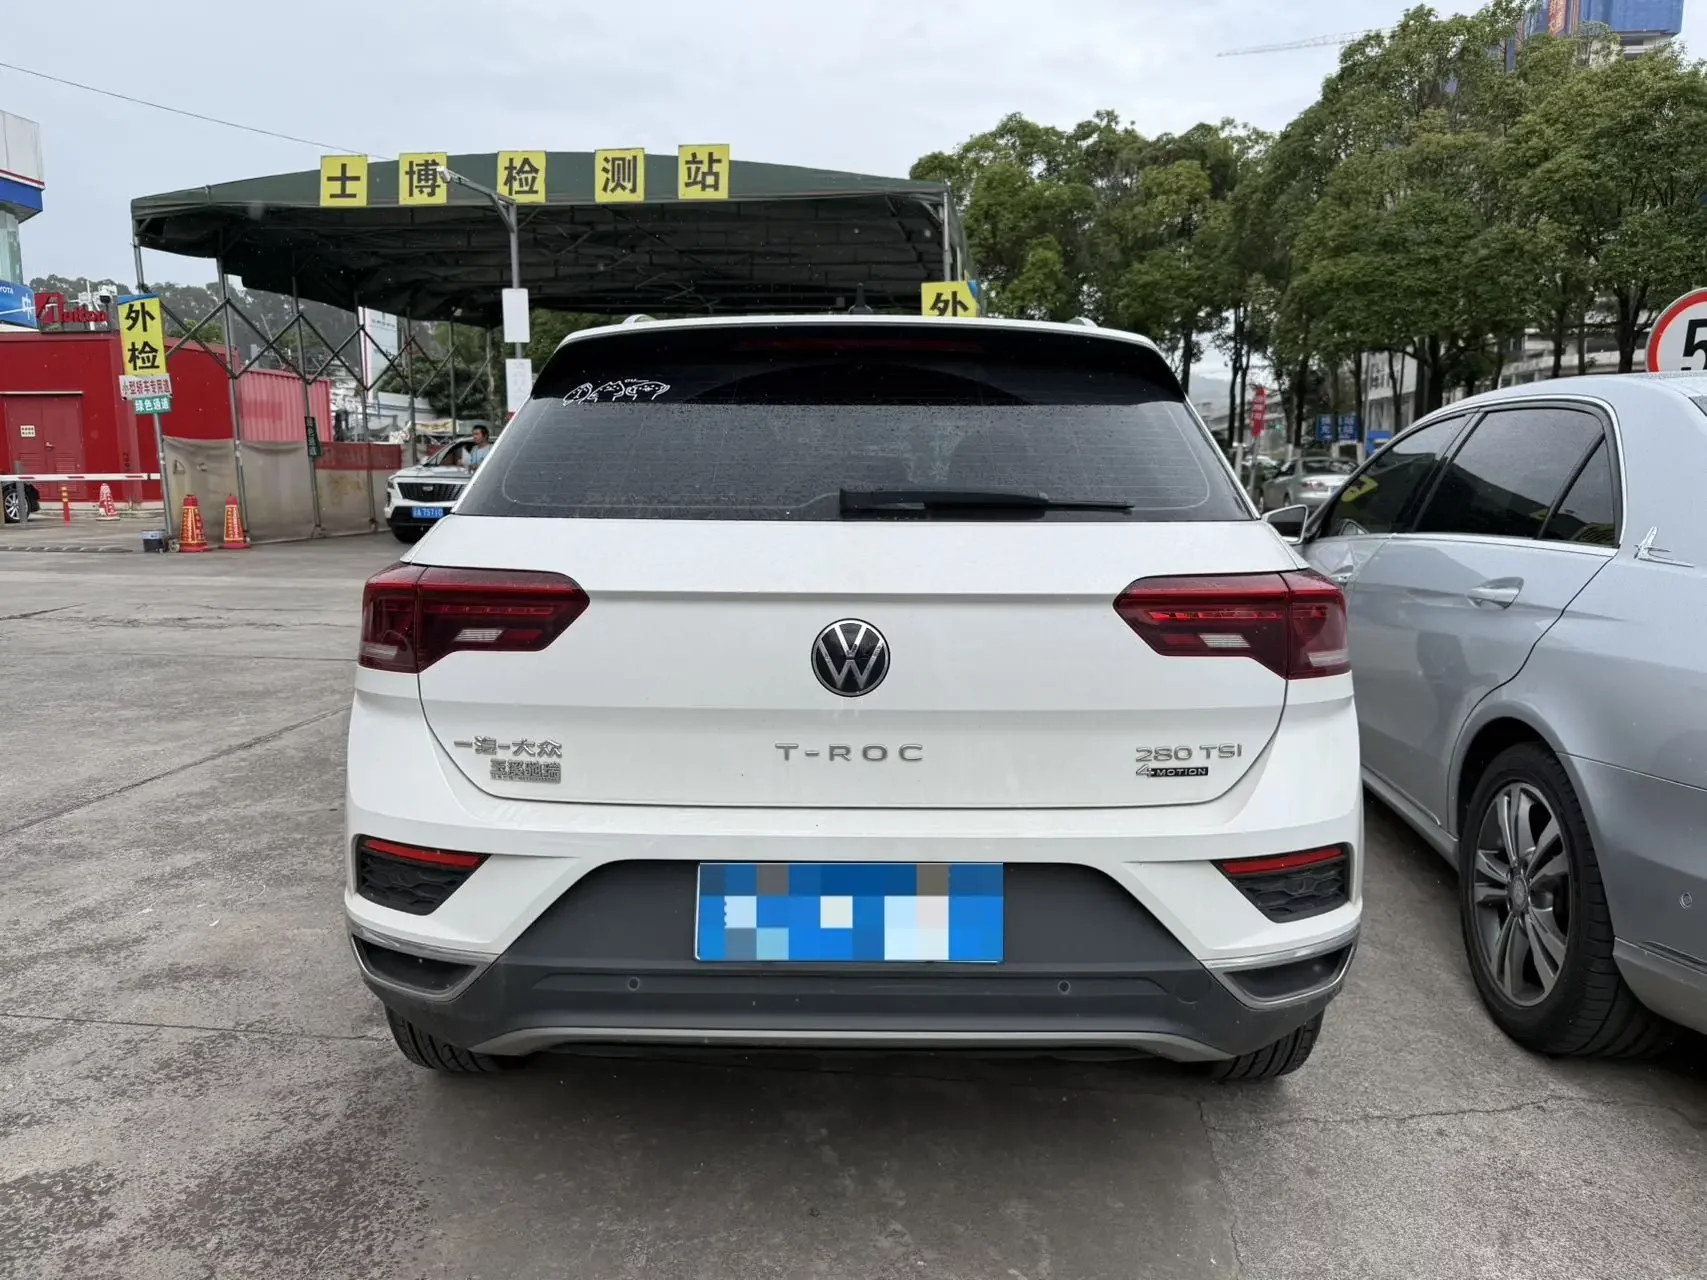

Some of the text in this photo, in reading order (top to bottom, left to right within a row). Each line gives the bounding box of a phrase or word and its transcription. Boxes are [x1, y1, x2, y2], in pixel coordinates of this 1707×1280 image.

[929, 290, 969, 317] 外
[124, 301, 160, 371] 外检
[774, 742, 924, 762] T-ROC
[1135, 742, 1243, 763] 280 TSI
